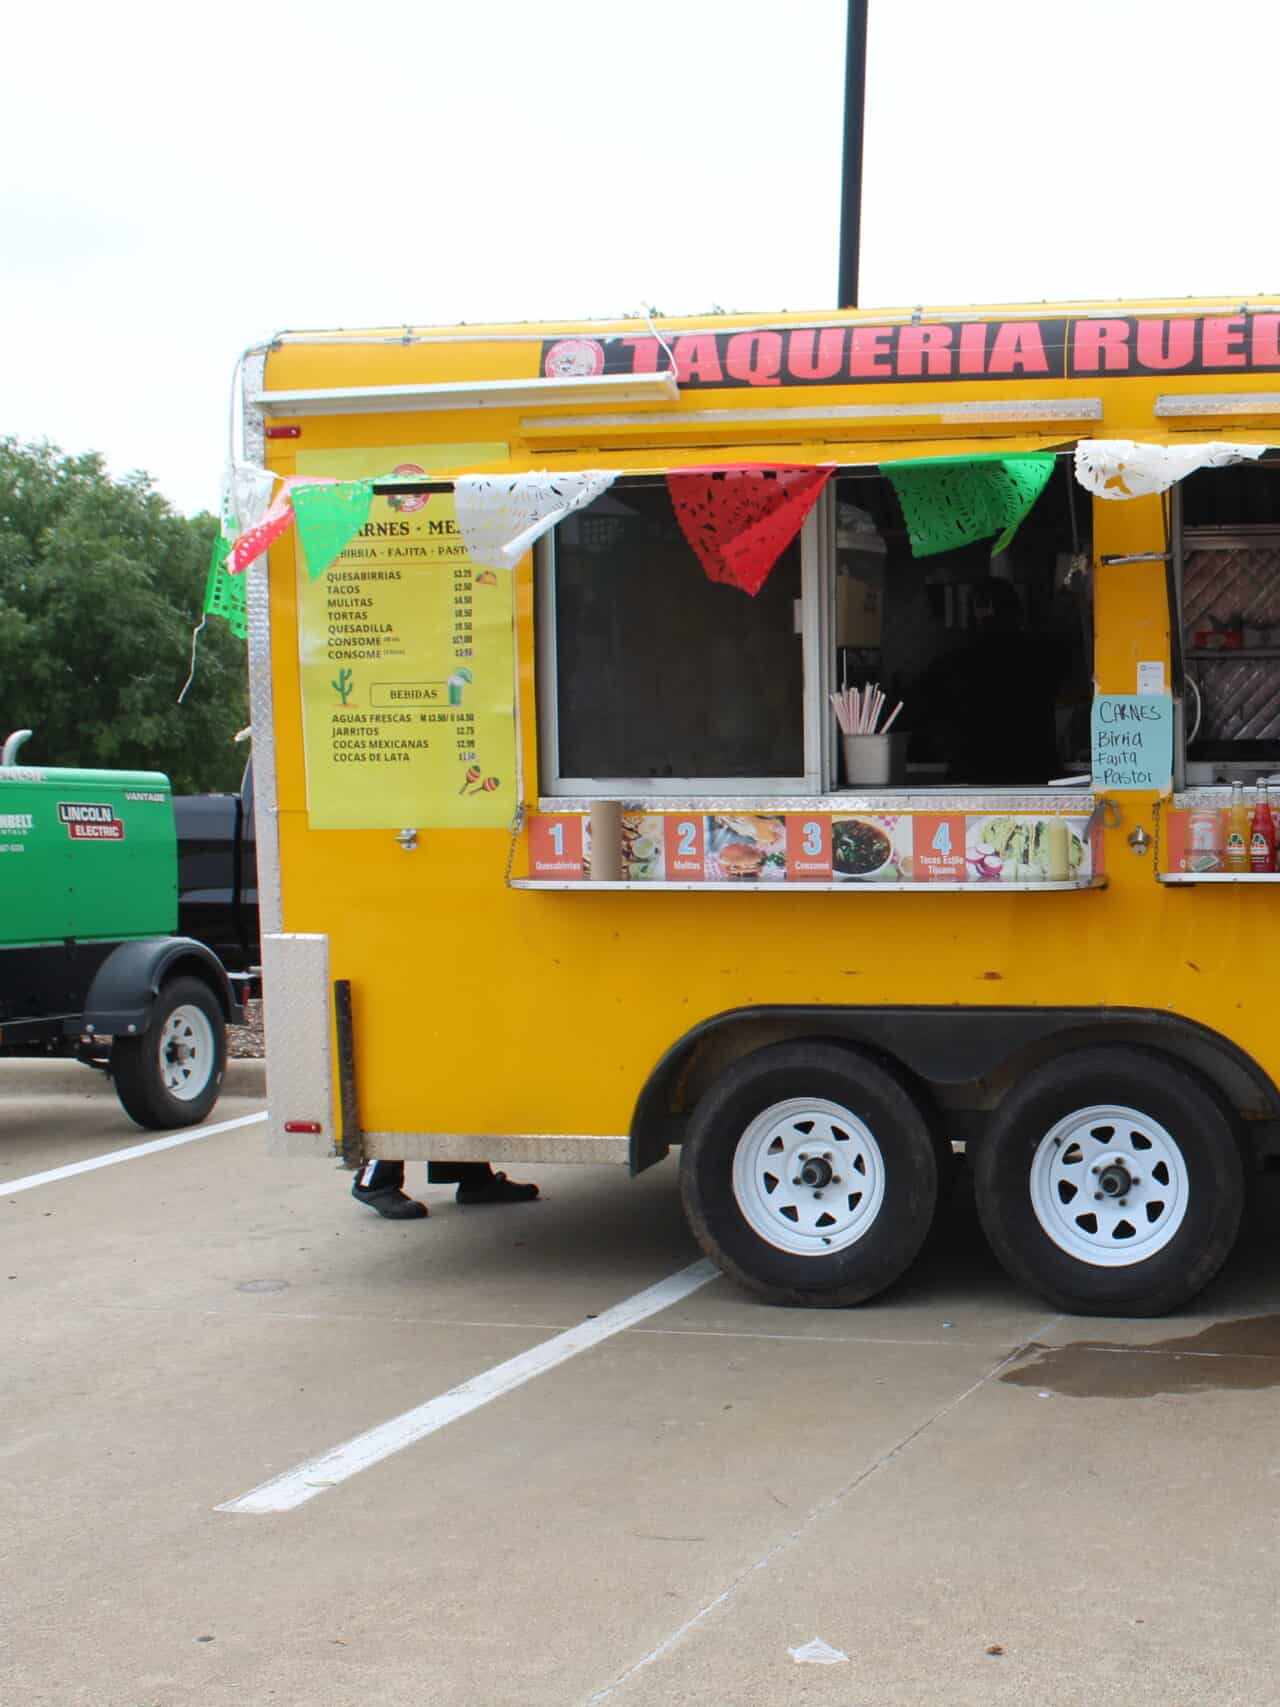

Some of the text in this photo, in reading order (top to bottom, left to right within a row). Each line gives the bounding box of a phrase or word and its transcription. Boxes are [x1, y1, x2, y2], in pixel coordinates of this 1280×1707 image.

[621, 321, 1048, 386] TAQUERIA
[358, 521, 410, 537] RNES
[387, 546, 427, 558] FAJITA
[437, 544, 468, 556] PAST
[326, 571, 402, 583] QUESABIRRIAS
[327, 585, 360, 595] TACOS
[327, 598, 373, 608] MULITAS
[328, 611, 368, 621] TORTAS
[328, 623, 393, 635] QUESADILLA
[327, 636, 381, 647] CONSOME
[328, 649, 381, 660] CONSOME
[390, 689, 438, 700] BEBIDAS
[331, 713, 367, 723] AGUAS
[369, 713, 412, 722] FRESCAS
[1100, 701, 1162, 724] CARNES
[331, 727, 379, 738] JARRITOS
[332, 740, 366, 750] COCAS
[369, 739, 430, 749] MEXICANAS
[333, 753, 366, 762] COCAS
[369, 753, 380, 762] DE
[384, 753, 410, 762] LATA
[125, 792, 166, 802] VANTAGE
[61, 806, 112, 822] LINCOLN
[75, 825, 120, 837] ELECTRIC
[548, 823, 564, 856] 1
[677, 822, 697, 856] 2
[802, 822, 822, 856] 3
[931, 821, 952, 856] 4
